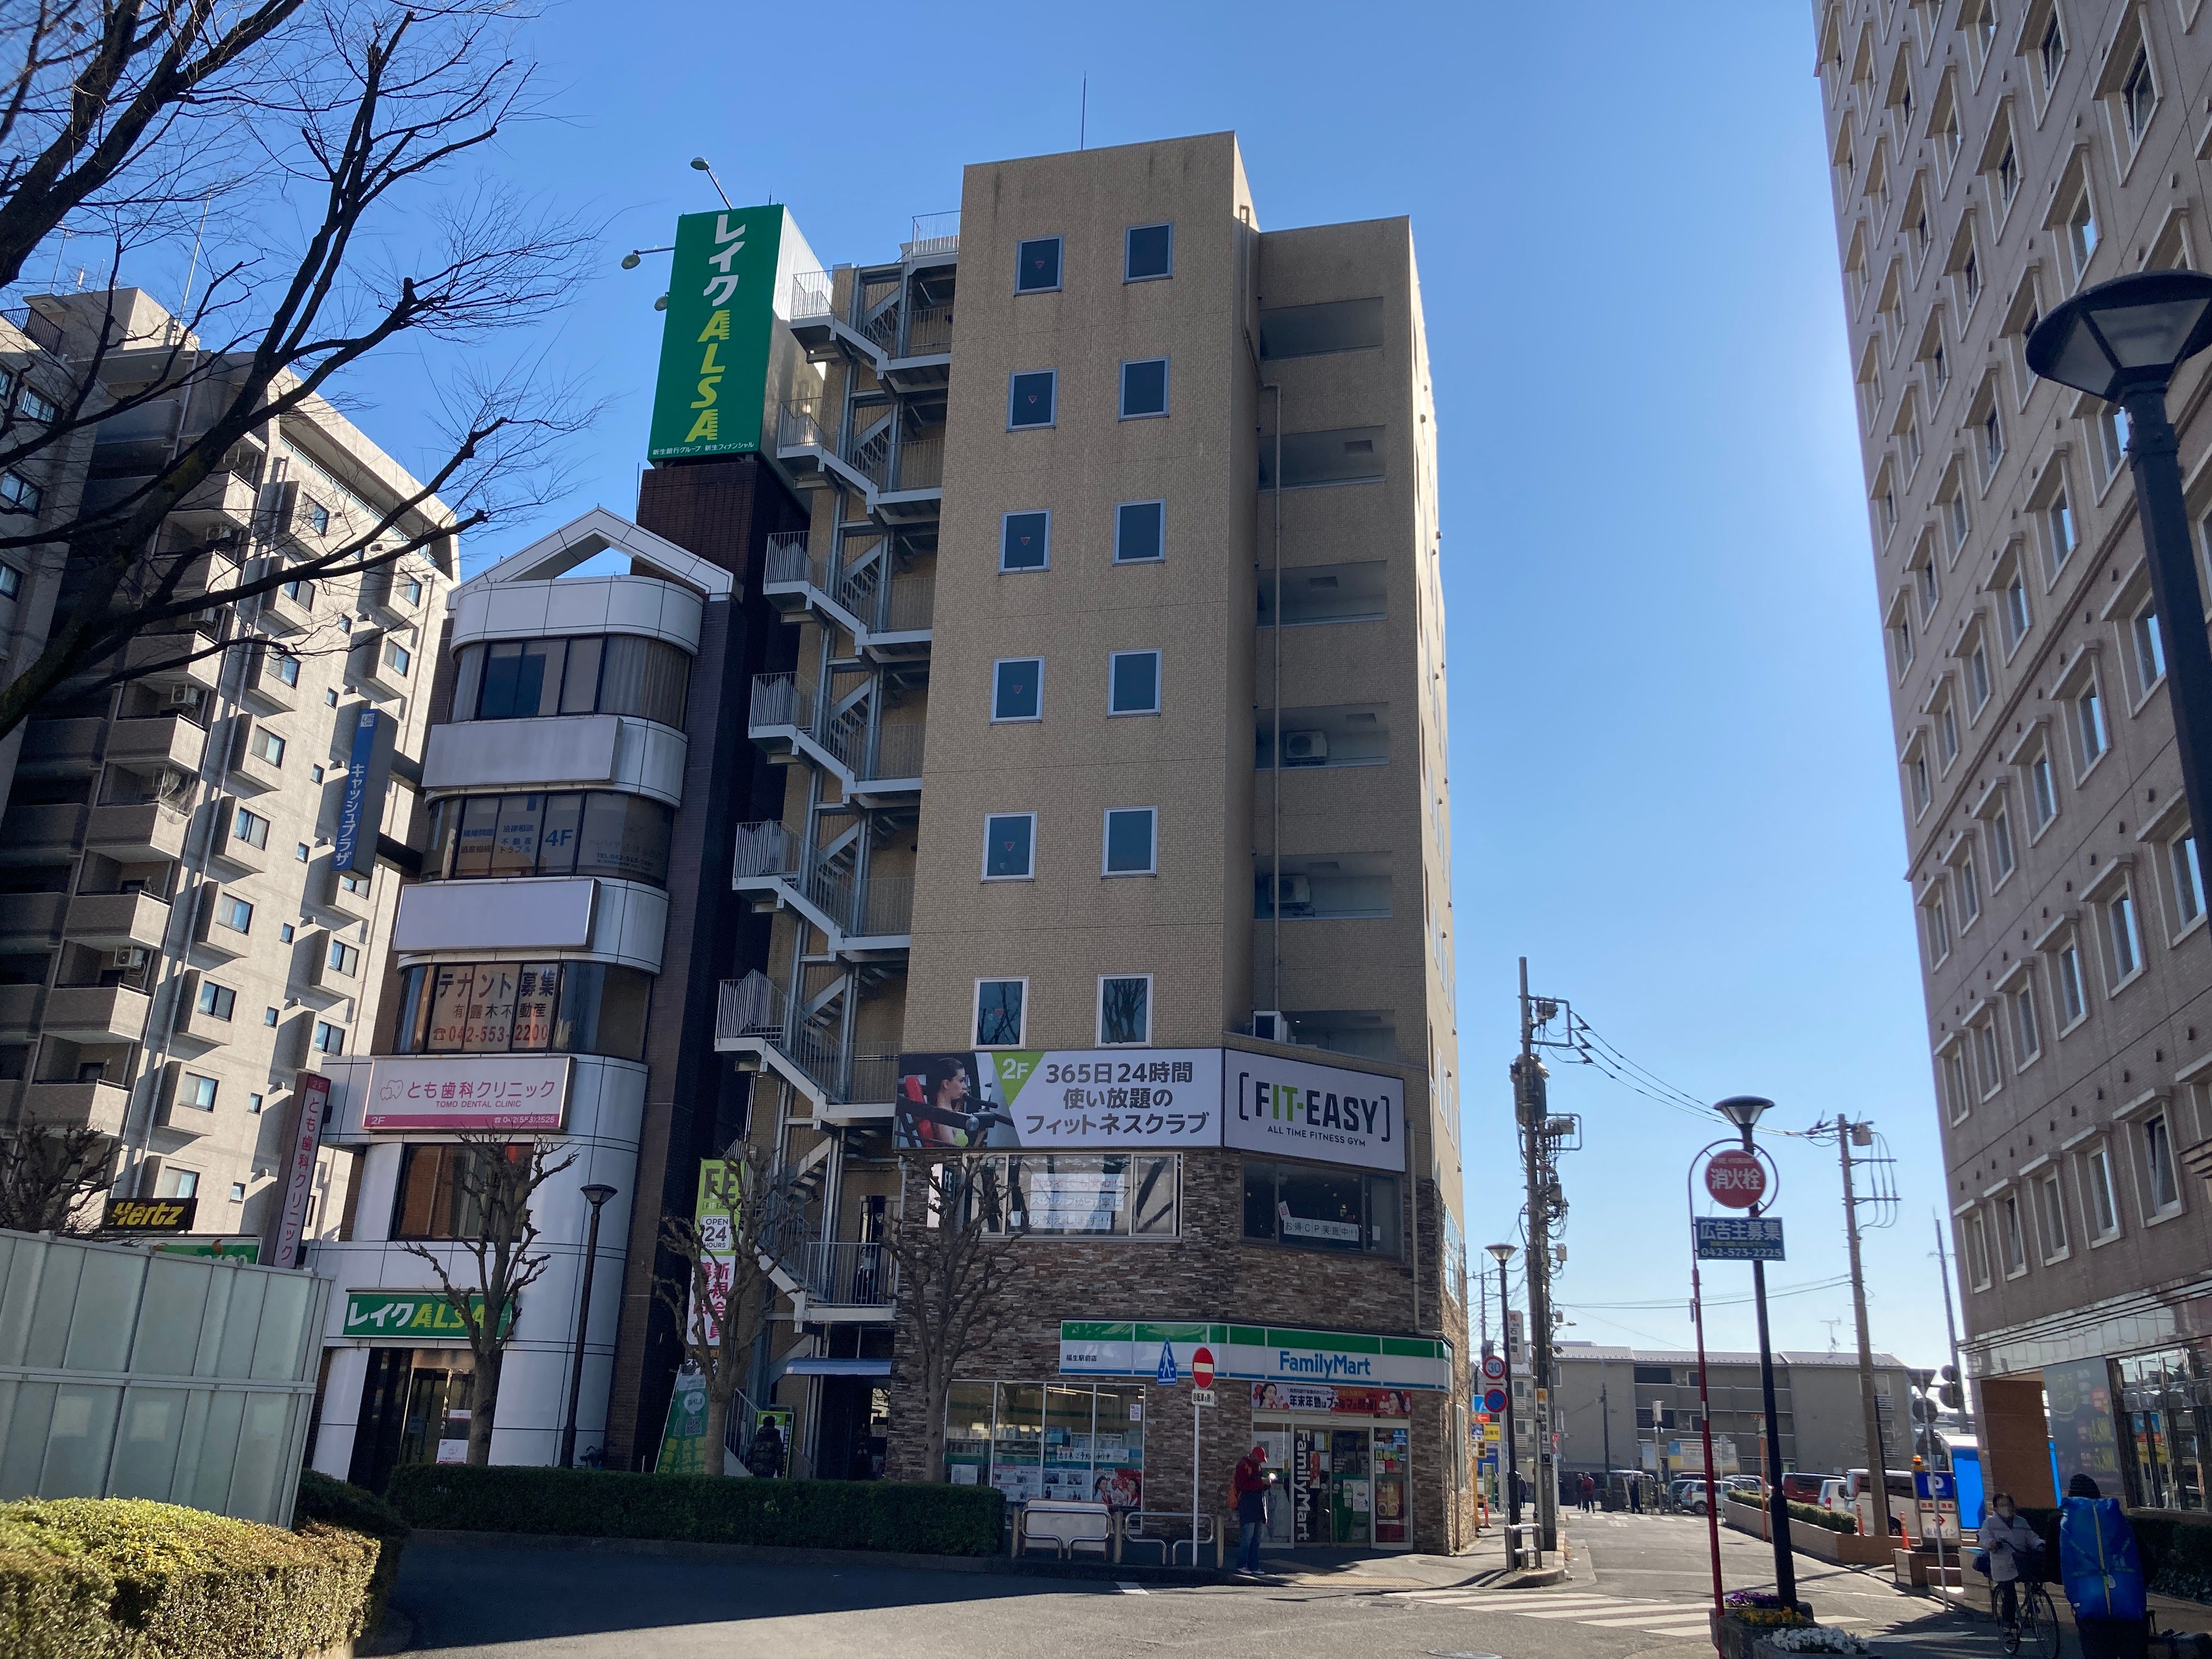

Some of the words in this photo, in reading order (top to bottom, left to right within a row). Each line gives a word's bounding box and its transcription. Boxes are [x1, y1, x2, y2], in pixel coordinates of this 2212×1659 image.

[336, 763, 365, 867] キャッシュプラザ
[545, 829, 573, 847] 4F
[449, 1024, 548, 1042] 042-553-2200
[1002, 1058, 1029, 1080] 2F
[1046, 1061, 1193, 1084] 365日24時間
[312, 1079, 324, 1089] 2F
[407, 1080, 555, 1098] とも歯科クリニック
[1063, 1087, 1173, 1109] 使い放題の
[370, 1116, 385, 1125] 2F
[1026, 1111, 1210, 1135] フィットネスクラブ
[1267, 1125, 1283, 1134] ALL
[1286, 1128, 1307, 1138] TIME
[1310, 1131, 1345, 1143] FITNESS
[1347, 1137, 1365, 1147] GYM
[280, 1097, 320, 1260] とも歯科クリニック
[1711, 1167, 1762, 1190] 消火栓
[112, 1203, 184, 1226] Hertz
[704, 1226, 727, 1242] 24
[1701, 1221, 1781, 1241] 広告主募集
[1280, 1351, 1370, 1380] FamilyMart
[1487, 1363, 1501, 1373] 30
[1293, 1429, 1311, 1541] FamilyMart
